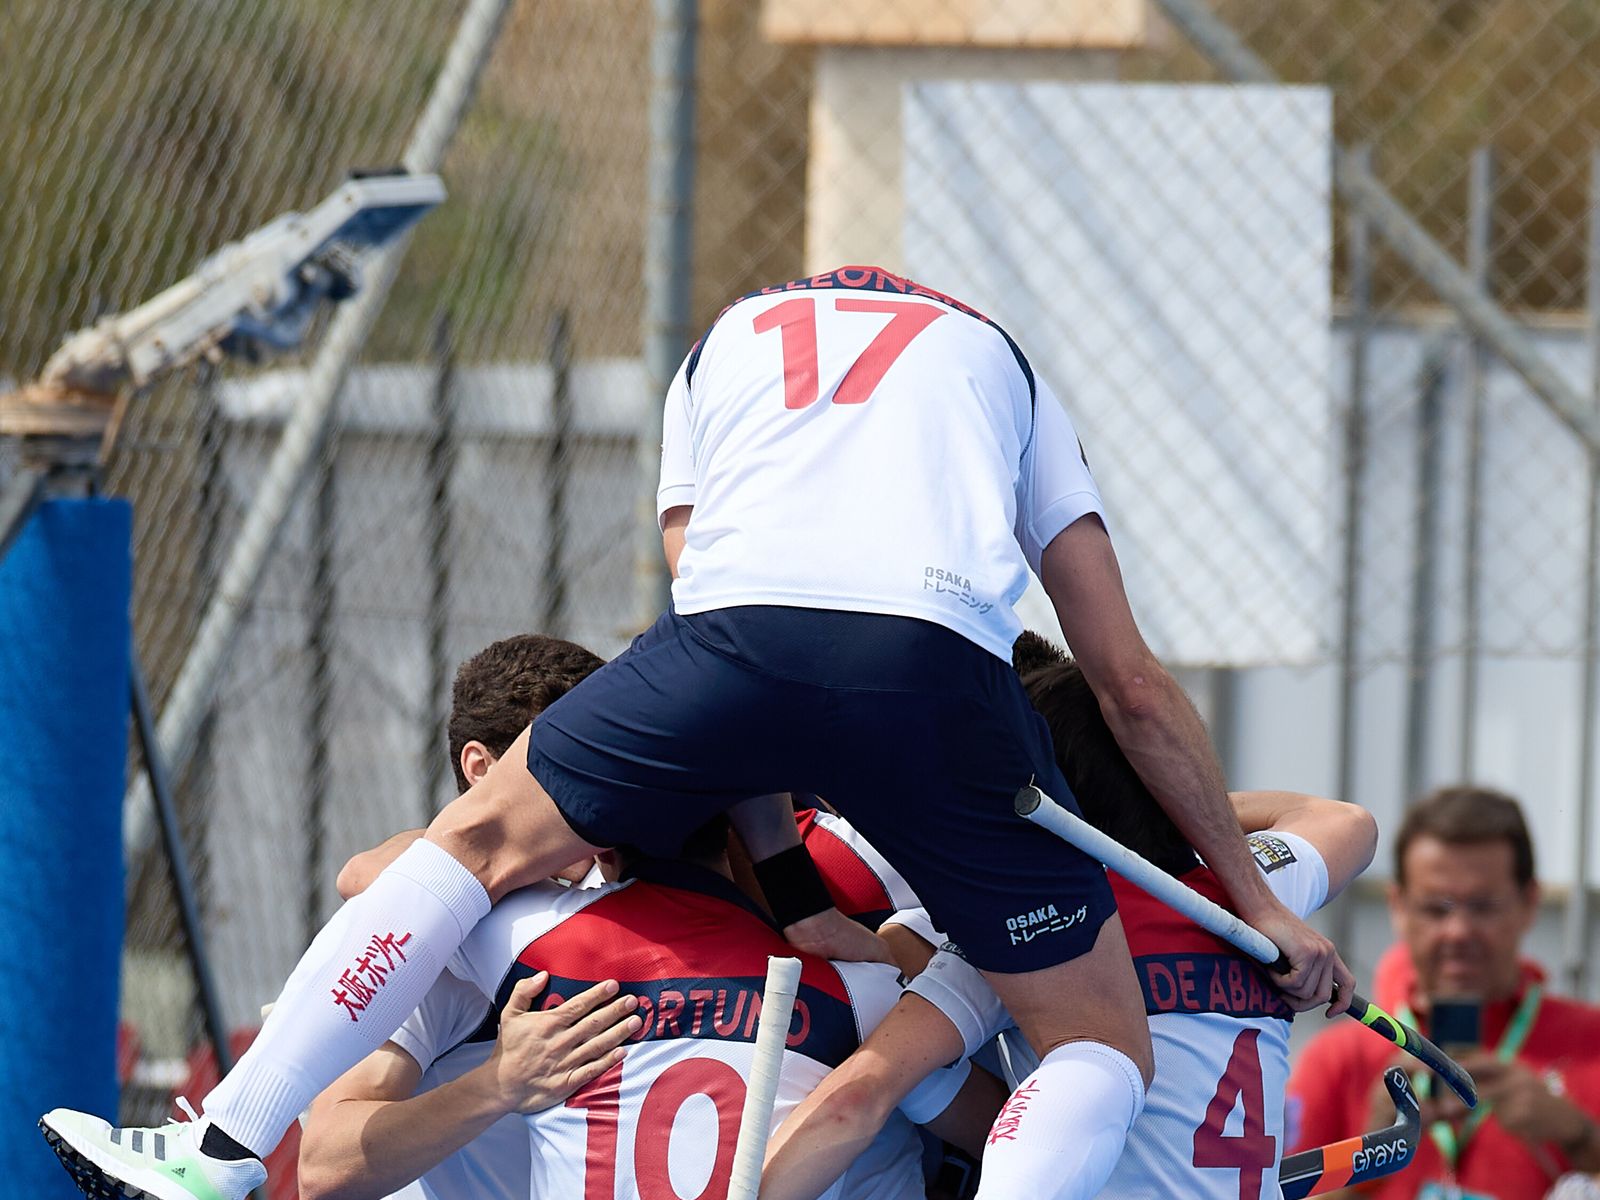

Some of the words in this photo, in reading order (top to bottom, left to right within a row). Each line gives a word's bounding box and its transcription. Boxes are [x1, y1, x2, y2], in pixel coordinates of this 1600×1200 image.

[753, 298, 948, 409] 17
[924, 579, 993, 614] トレーニング
[925, 566, 971, 592] OSAKA
[1006, 904, 1058, 931] OSAKA
[1010, 905, 1087, 945] トレーニング
[1146, 960, 1200, 1011] DE
